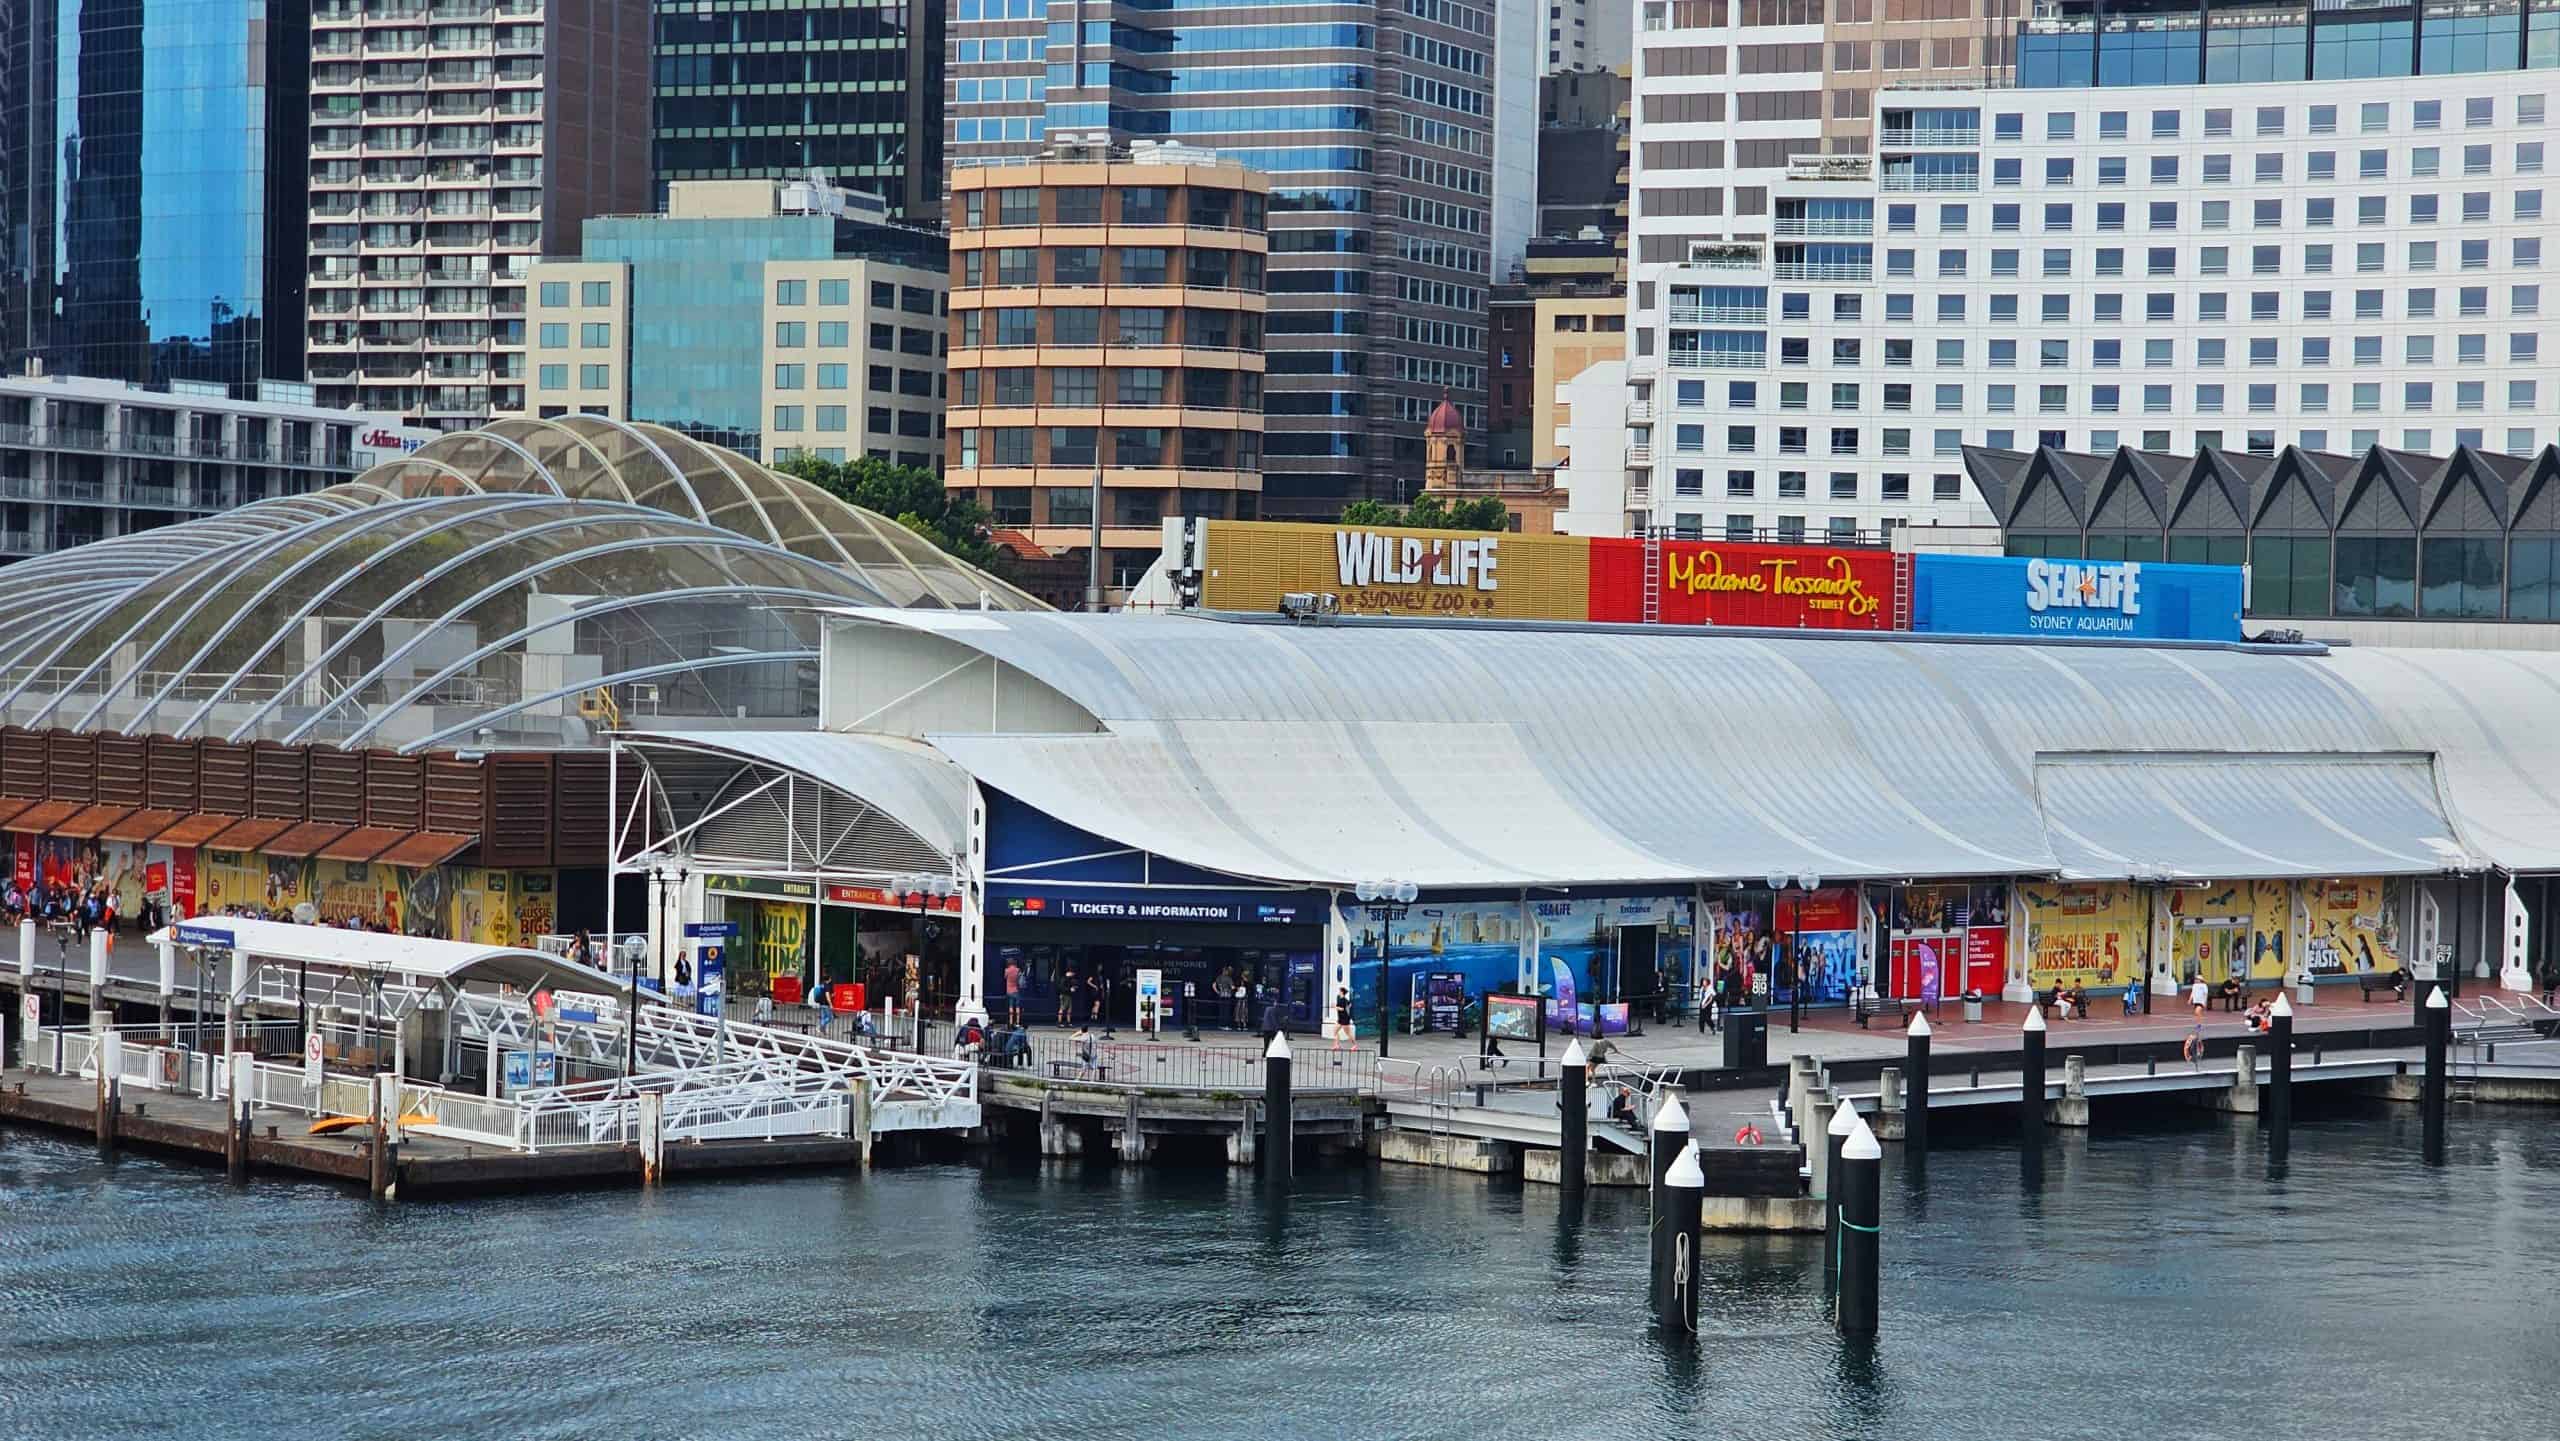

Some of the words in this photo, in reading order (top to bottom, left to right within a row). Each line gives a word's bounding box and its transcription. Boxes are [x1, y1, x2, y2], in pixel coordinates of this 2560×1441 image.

[1336, 530, 1423, 586] WILD
[1432, 537, 1497, 590] LIFE
[1669, 551, 1766, 595] Madame
[1760, 556, 1867, 615] Tussauds
[2027, 558, 2082, 611] SEA
[1359, 591, 1425, 609] SYDNEY
[1432, 592, 1465, 610] ZOO
[1809, 600, 1844, 610] SYDNEY
[2030, 616, 2073, 629] SYDNEY
[2077, 617, 2133, 631] AQUARIUM
[783, 883, 812, 894] ENTRANCE
[842, 889, 877, 900] ENTRANCE
[1071, 903, 1125, 915] TICKETS
[1128, 905, 1137, 915] &
[1141, 906, 1228, 917] INFORMATION
[1620, 905, 1651, 913] Entrance
[2036, 950, 2075, 969] AUSSIE
[2078, 949, 2099, 968] BIG
[2103, 932, 2119, 973] 5
[2308, 949, 2340, 968] EASTS
